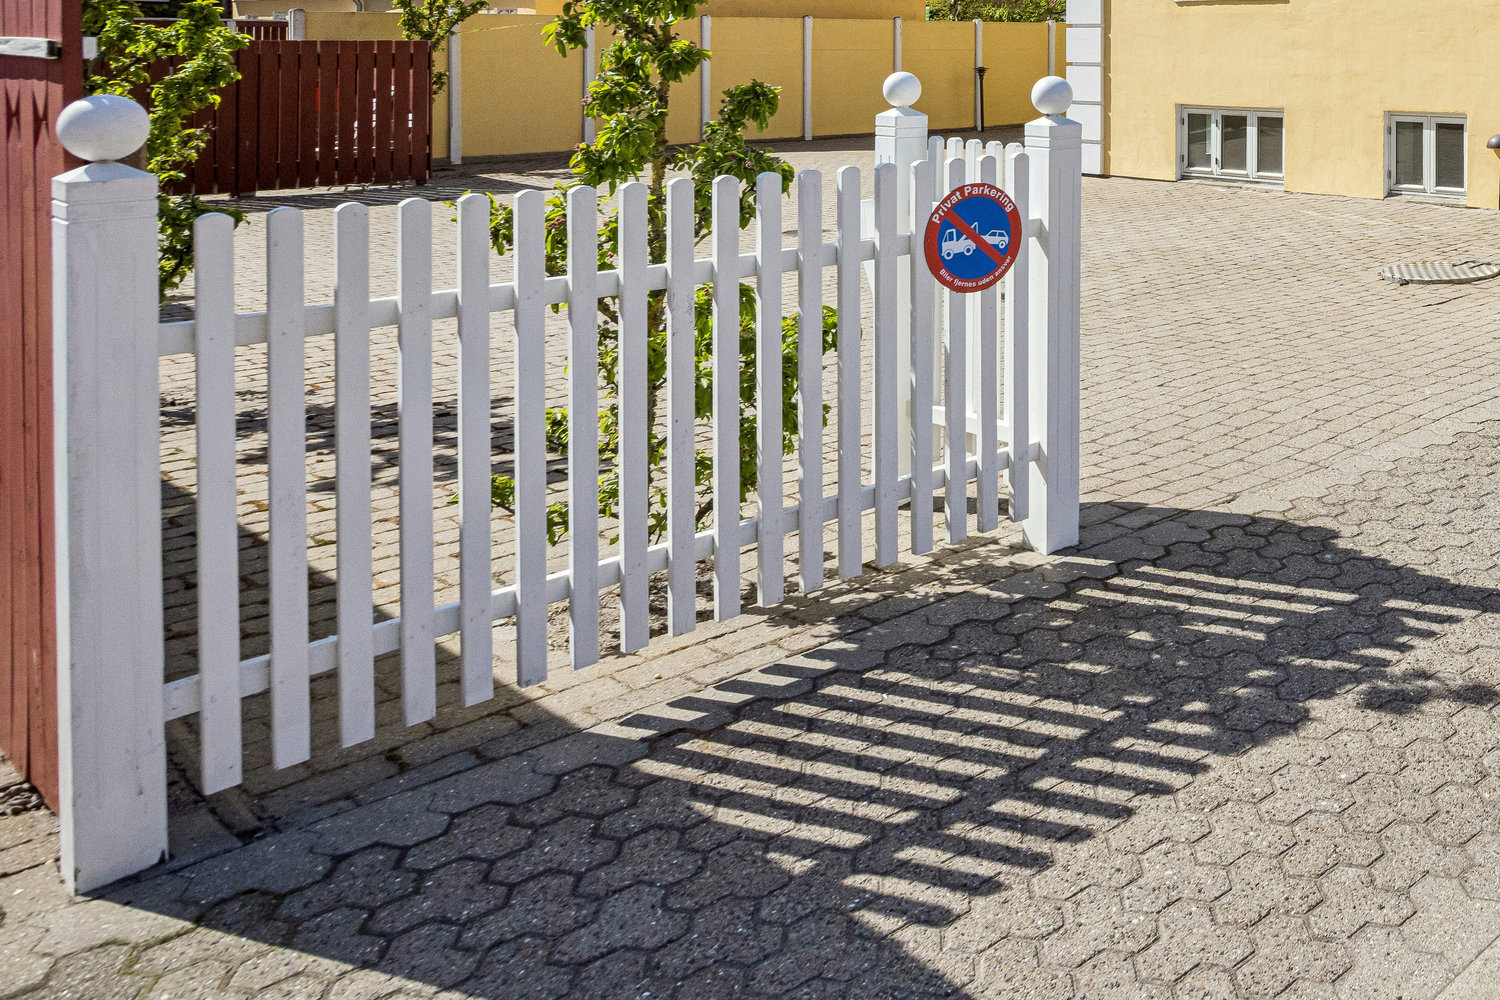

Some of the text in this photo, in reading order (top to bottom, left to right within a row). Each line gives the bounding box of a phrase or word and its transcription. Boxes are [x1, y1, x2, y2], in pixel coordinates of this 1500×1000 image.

[931, 185, 1015, 224] Privat Parkering
[939, 255, 1012, 287] Biler fjernes uden ansvar
